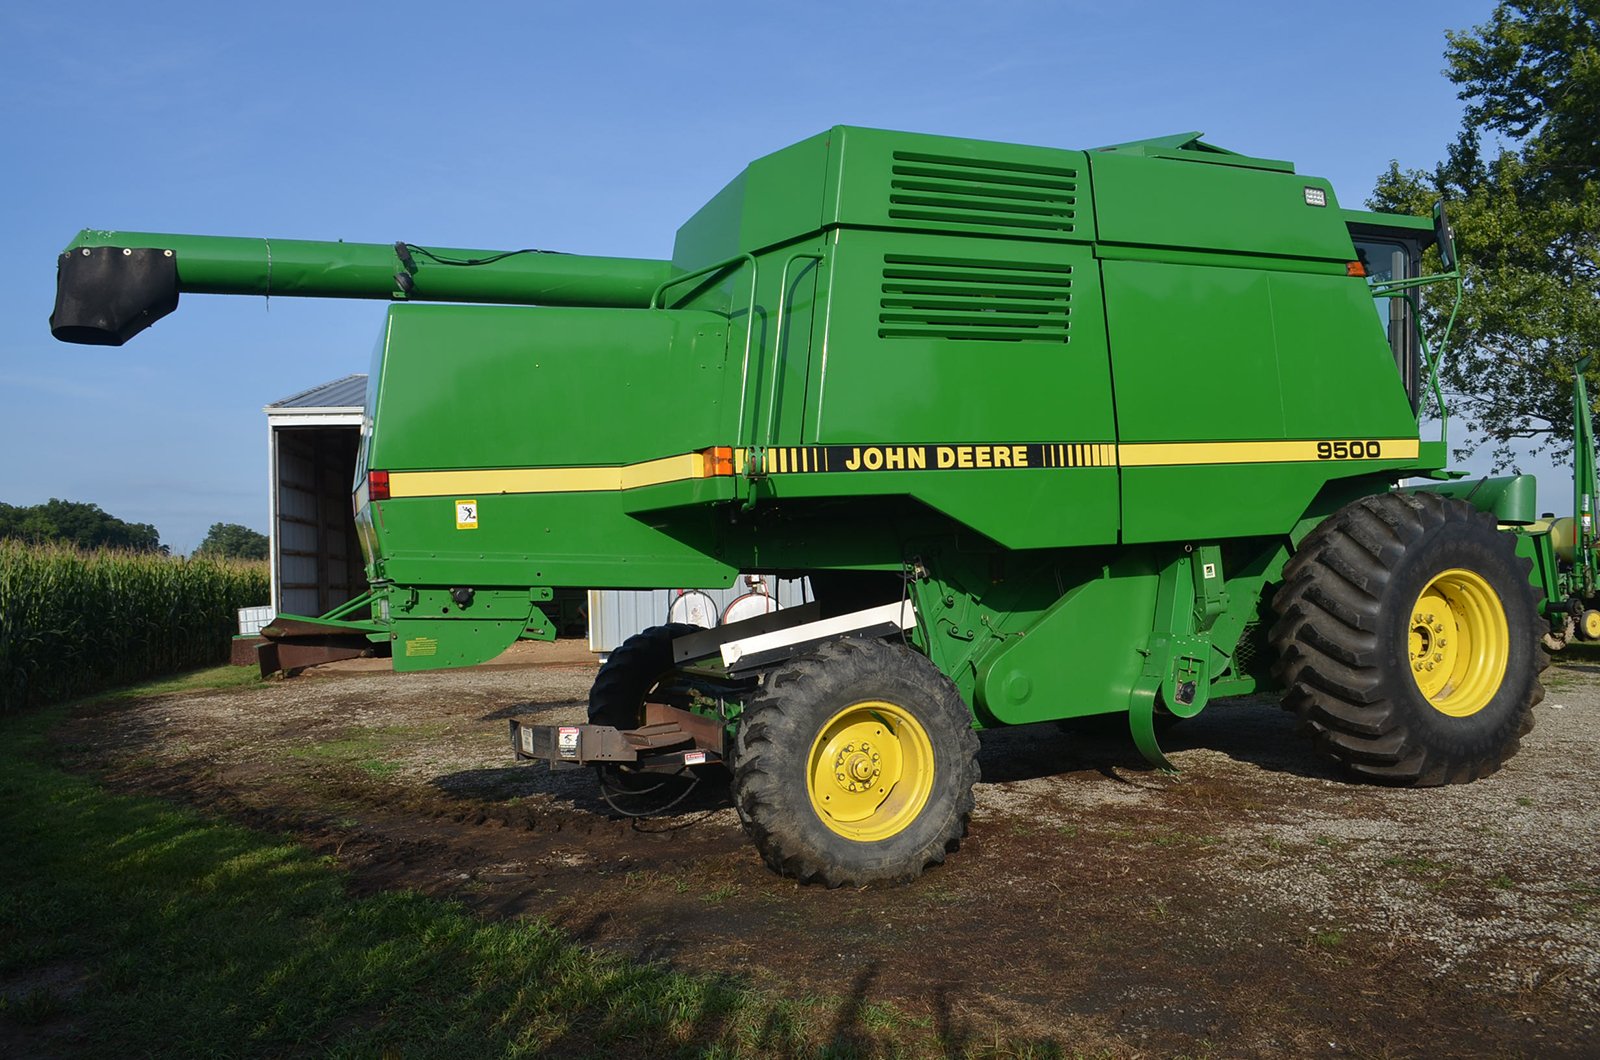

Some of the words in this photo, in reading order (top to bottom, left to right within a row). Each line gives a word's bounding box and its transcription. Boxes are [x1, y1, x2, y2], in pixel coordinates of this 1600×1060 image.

[845, 447, 925, 470] JOHN
[937, 446, 1028, 468] DEERE
[1317, 441, 1381, 459] 9500
